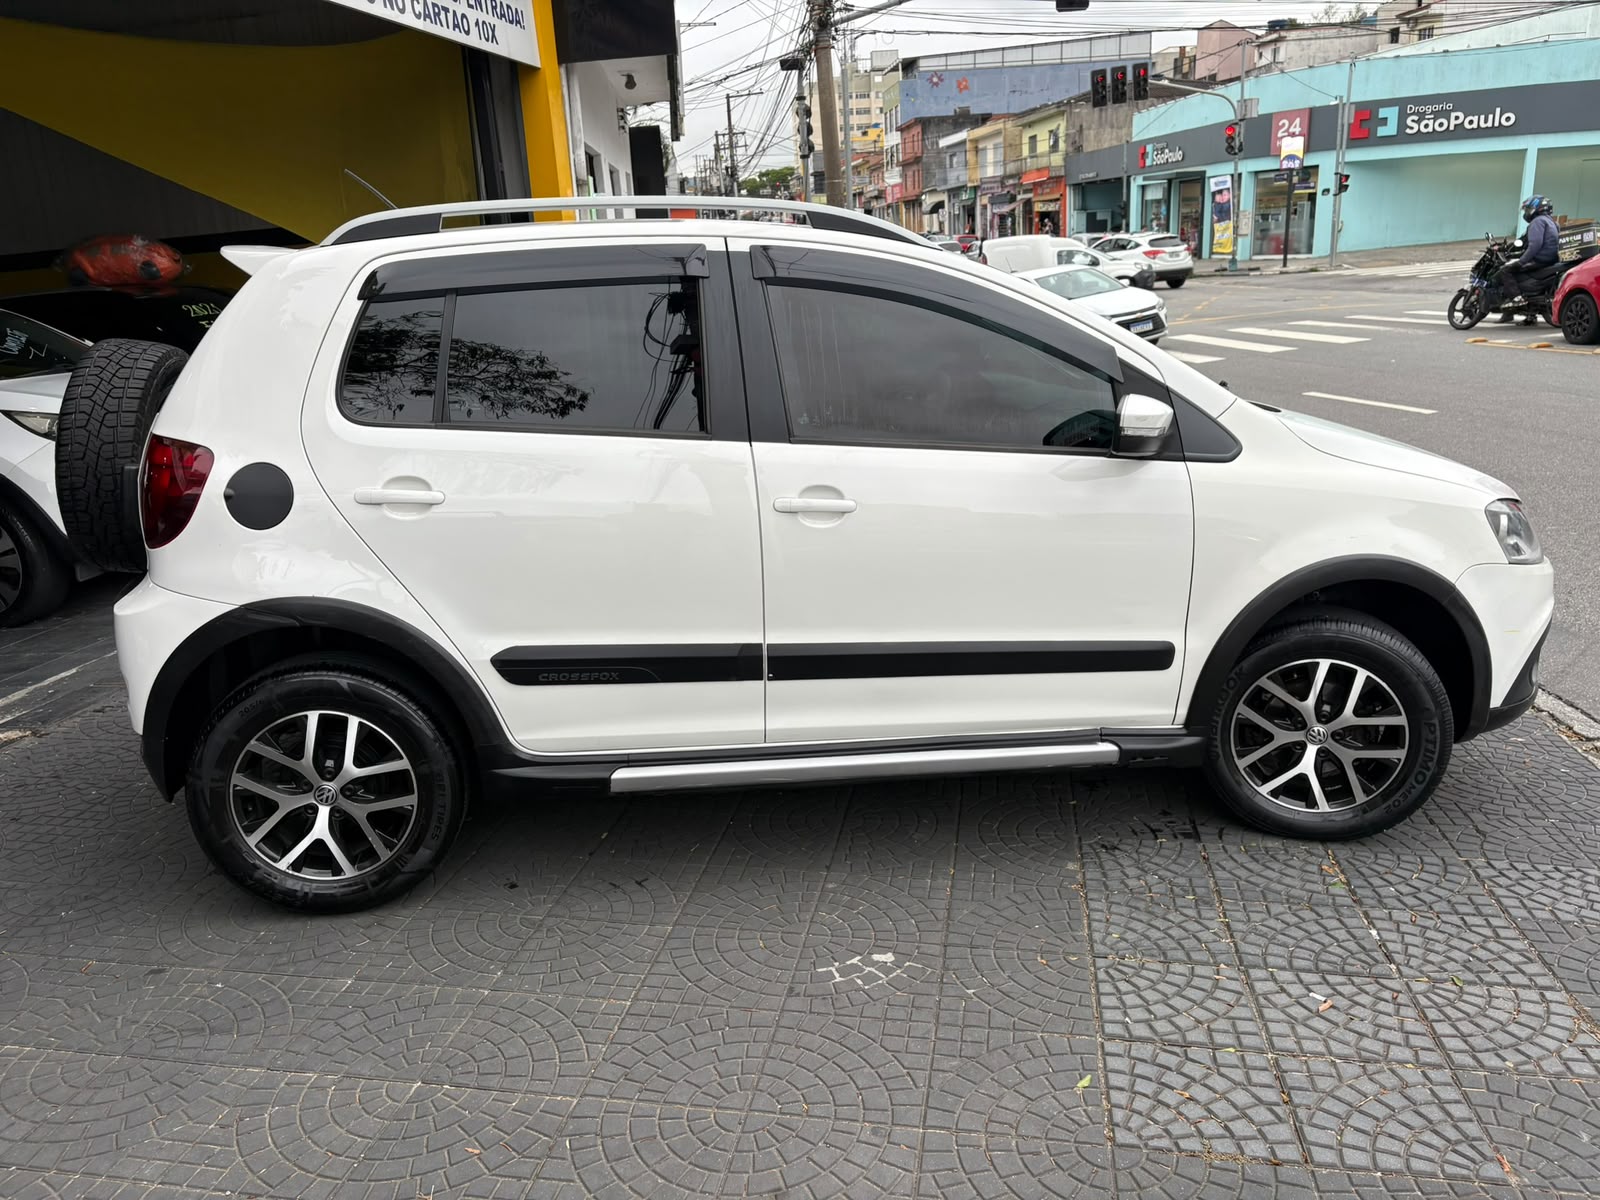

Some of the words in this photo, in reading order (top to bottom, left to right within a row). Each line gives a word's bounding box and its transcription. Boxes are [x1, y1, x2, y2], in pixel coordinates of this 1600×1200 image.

[475, 18, 499, 45] 10X
[1407, 102, 1453, 114] Drogaria
[1277, 117, 1302, 138] 24
[1405, 107, 1516, 134] SãoPaulo
[538, 672, 619, 681] CROSSFOX
[1413, 708, 1437, 786] PTIMO
